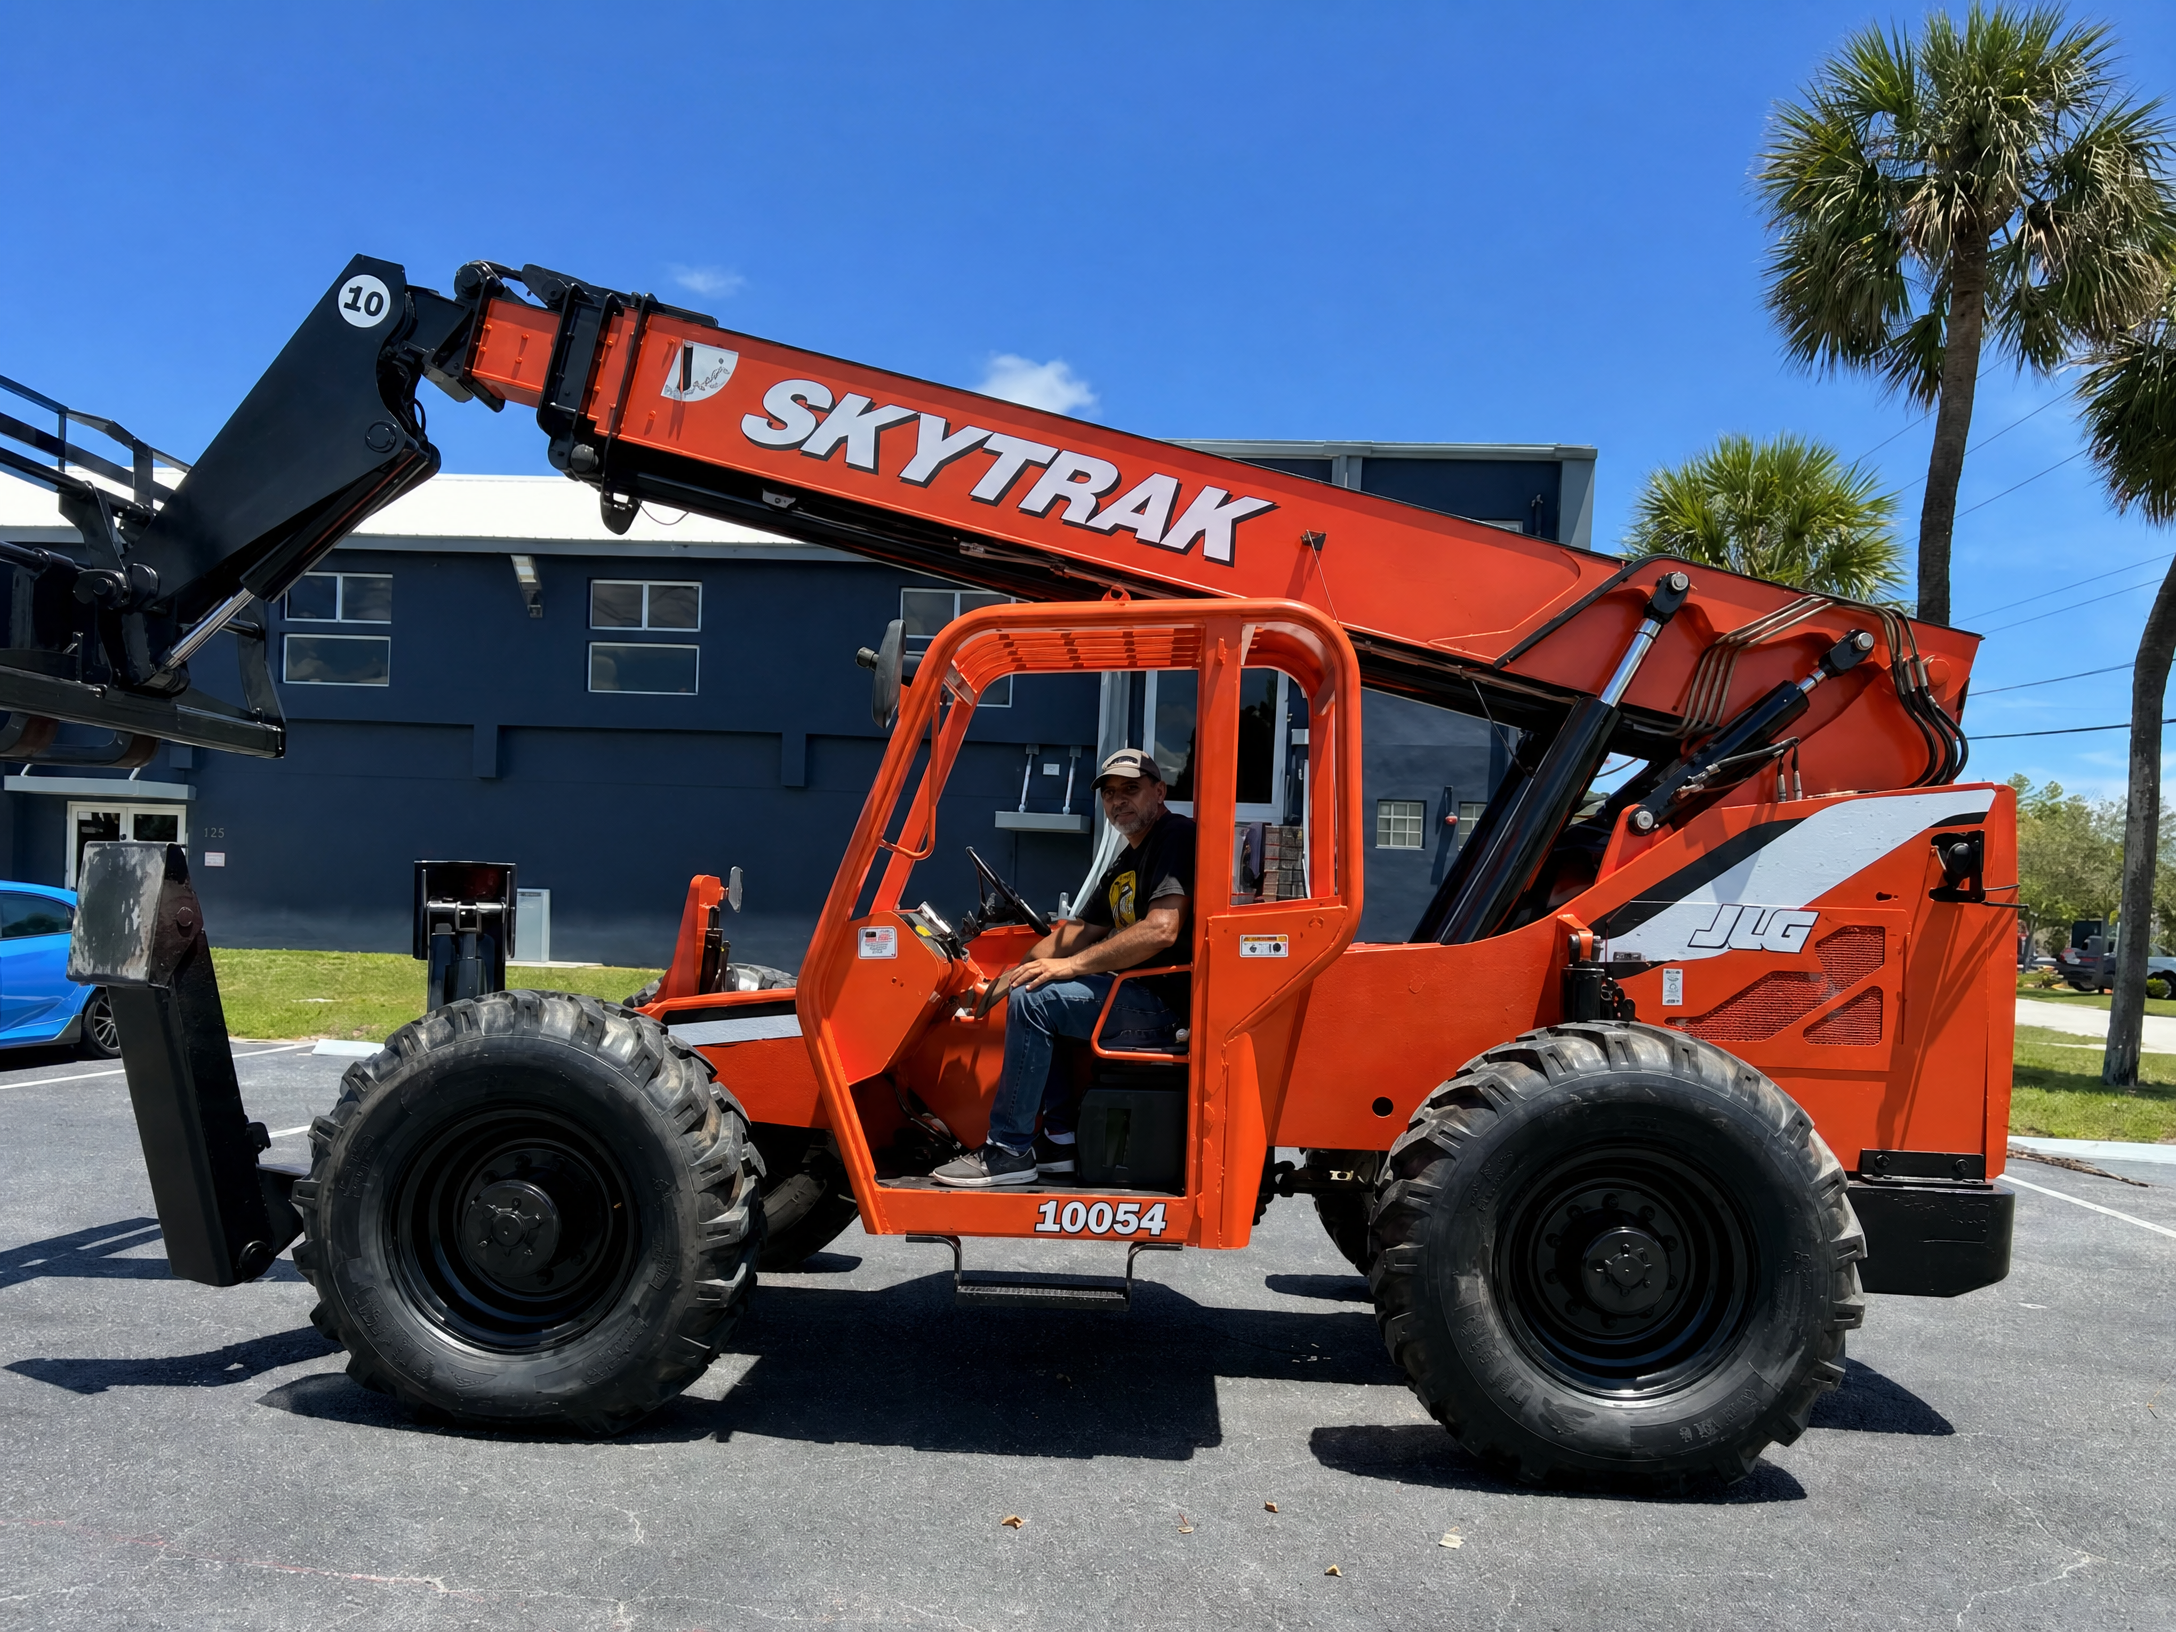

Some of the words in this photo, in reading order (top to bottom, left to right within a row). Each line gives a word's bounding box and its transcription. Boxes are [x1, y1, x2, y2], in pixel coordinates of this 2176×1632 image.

[343, 285, 385, 317] 10
[741, 379, 1278, 567] SKYTRAK
[204, 827, 225, 839] 125
[1687, 903, 1820, 954] JLG
[1034, 1199, 1168, 1237] 10054
